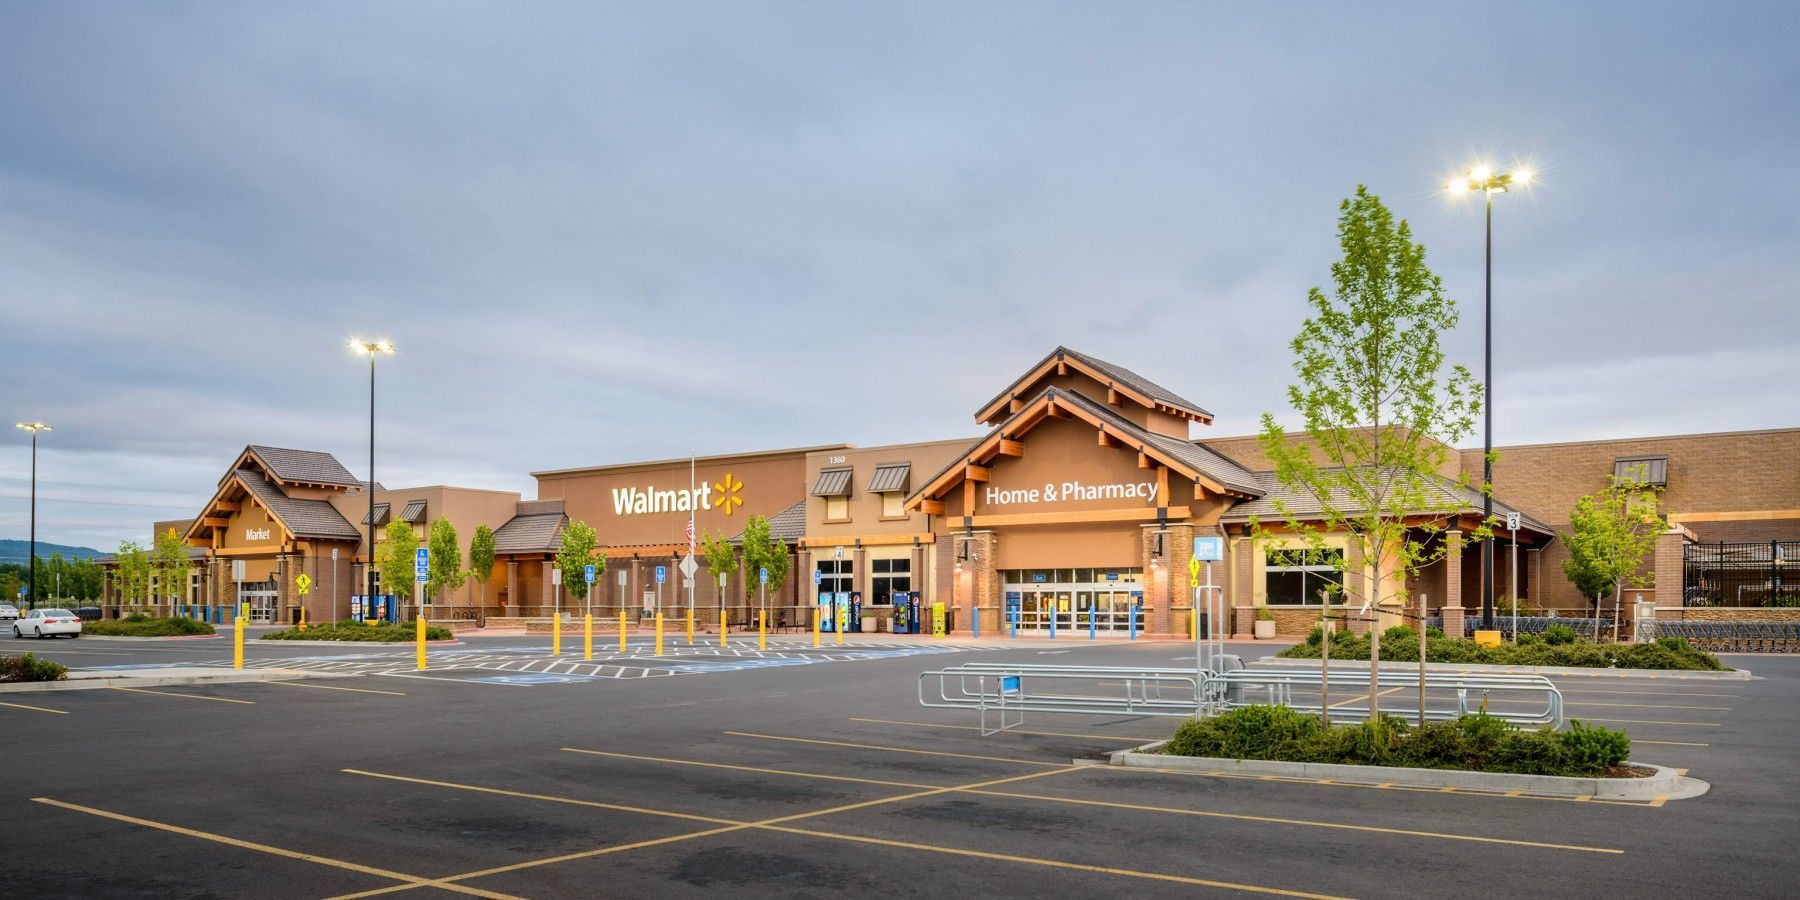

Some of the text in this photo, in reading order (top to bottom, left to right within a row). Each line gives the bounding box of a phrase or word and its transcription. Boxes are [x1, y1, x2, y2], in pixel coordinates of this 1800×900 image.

[830, 455, 845, 464] 1360
[612, 482, 711, 515] Walmart
[986, 481, 1158, 504] Home & Pharmacy
[1511, 518, 1516, 528] 3
[246, 528, 270, 541] Market
